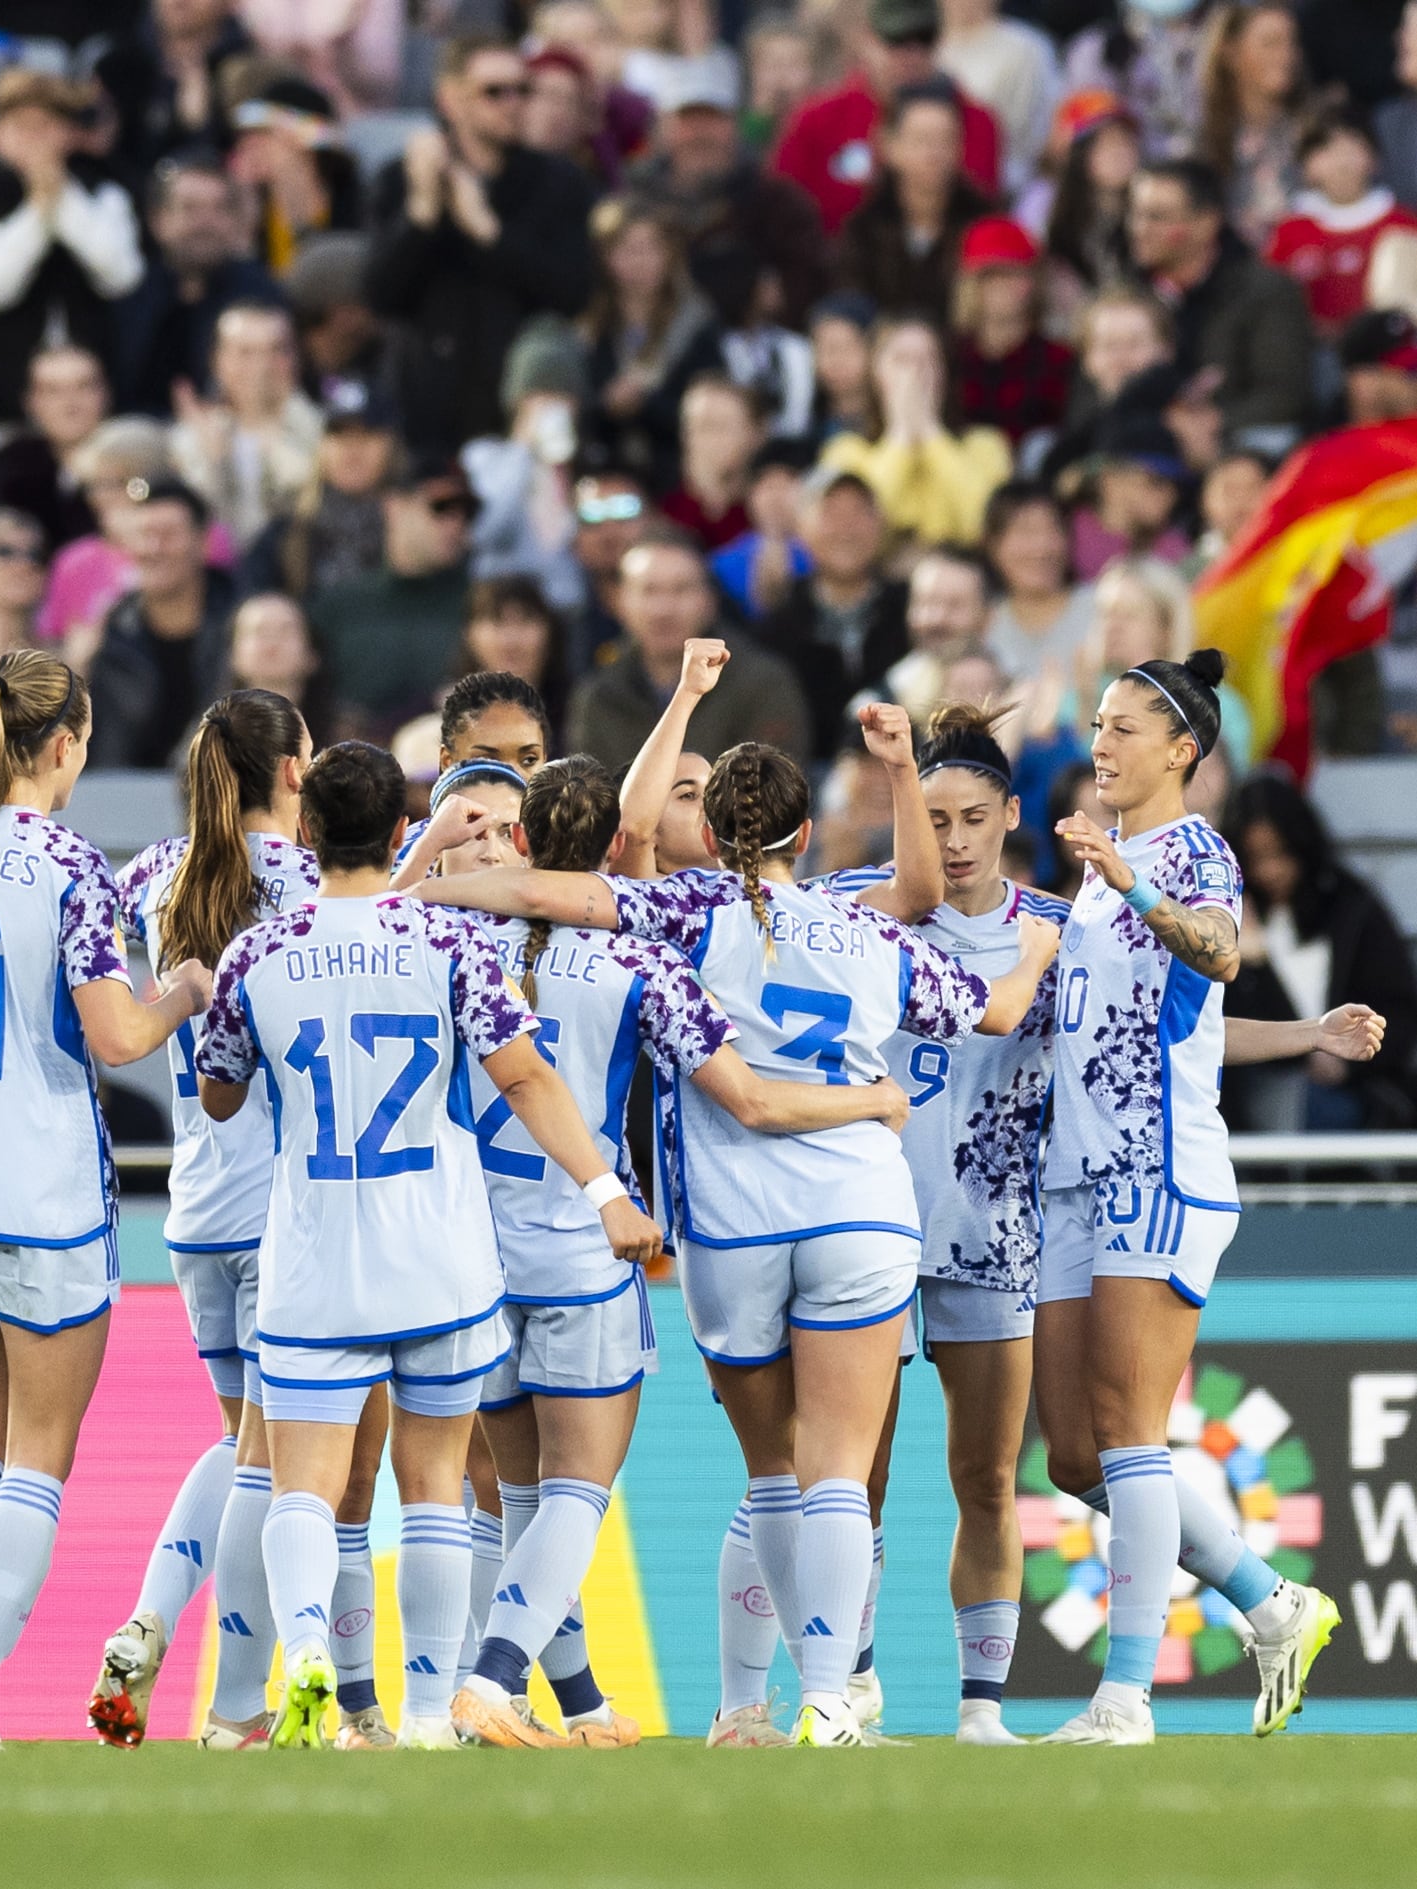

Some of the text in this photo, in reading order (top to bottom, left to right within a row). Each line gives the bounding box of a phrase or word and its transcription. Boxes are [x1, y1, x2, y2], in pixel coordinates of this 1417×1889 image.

[286, 942, 413, 982] OIHANE
[283, 1014, 441, 1181] 12
[909, 1042, 951, 1108] 9
